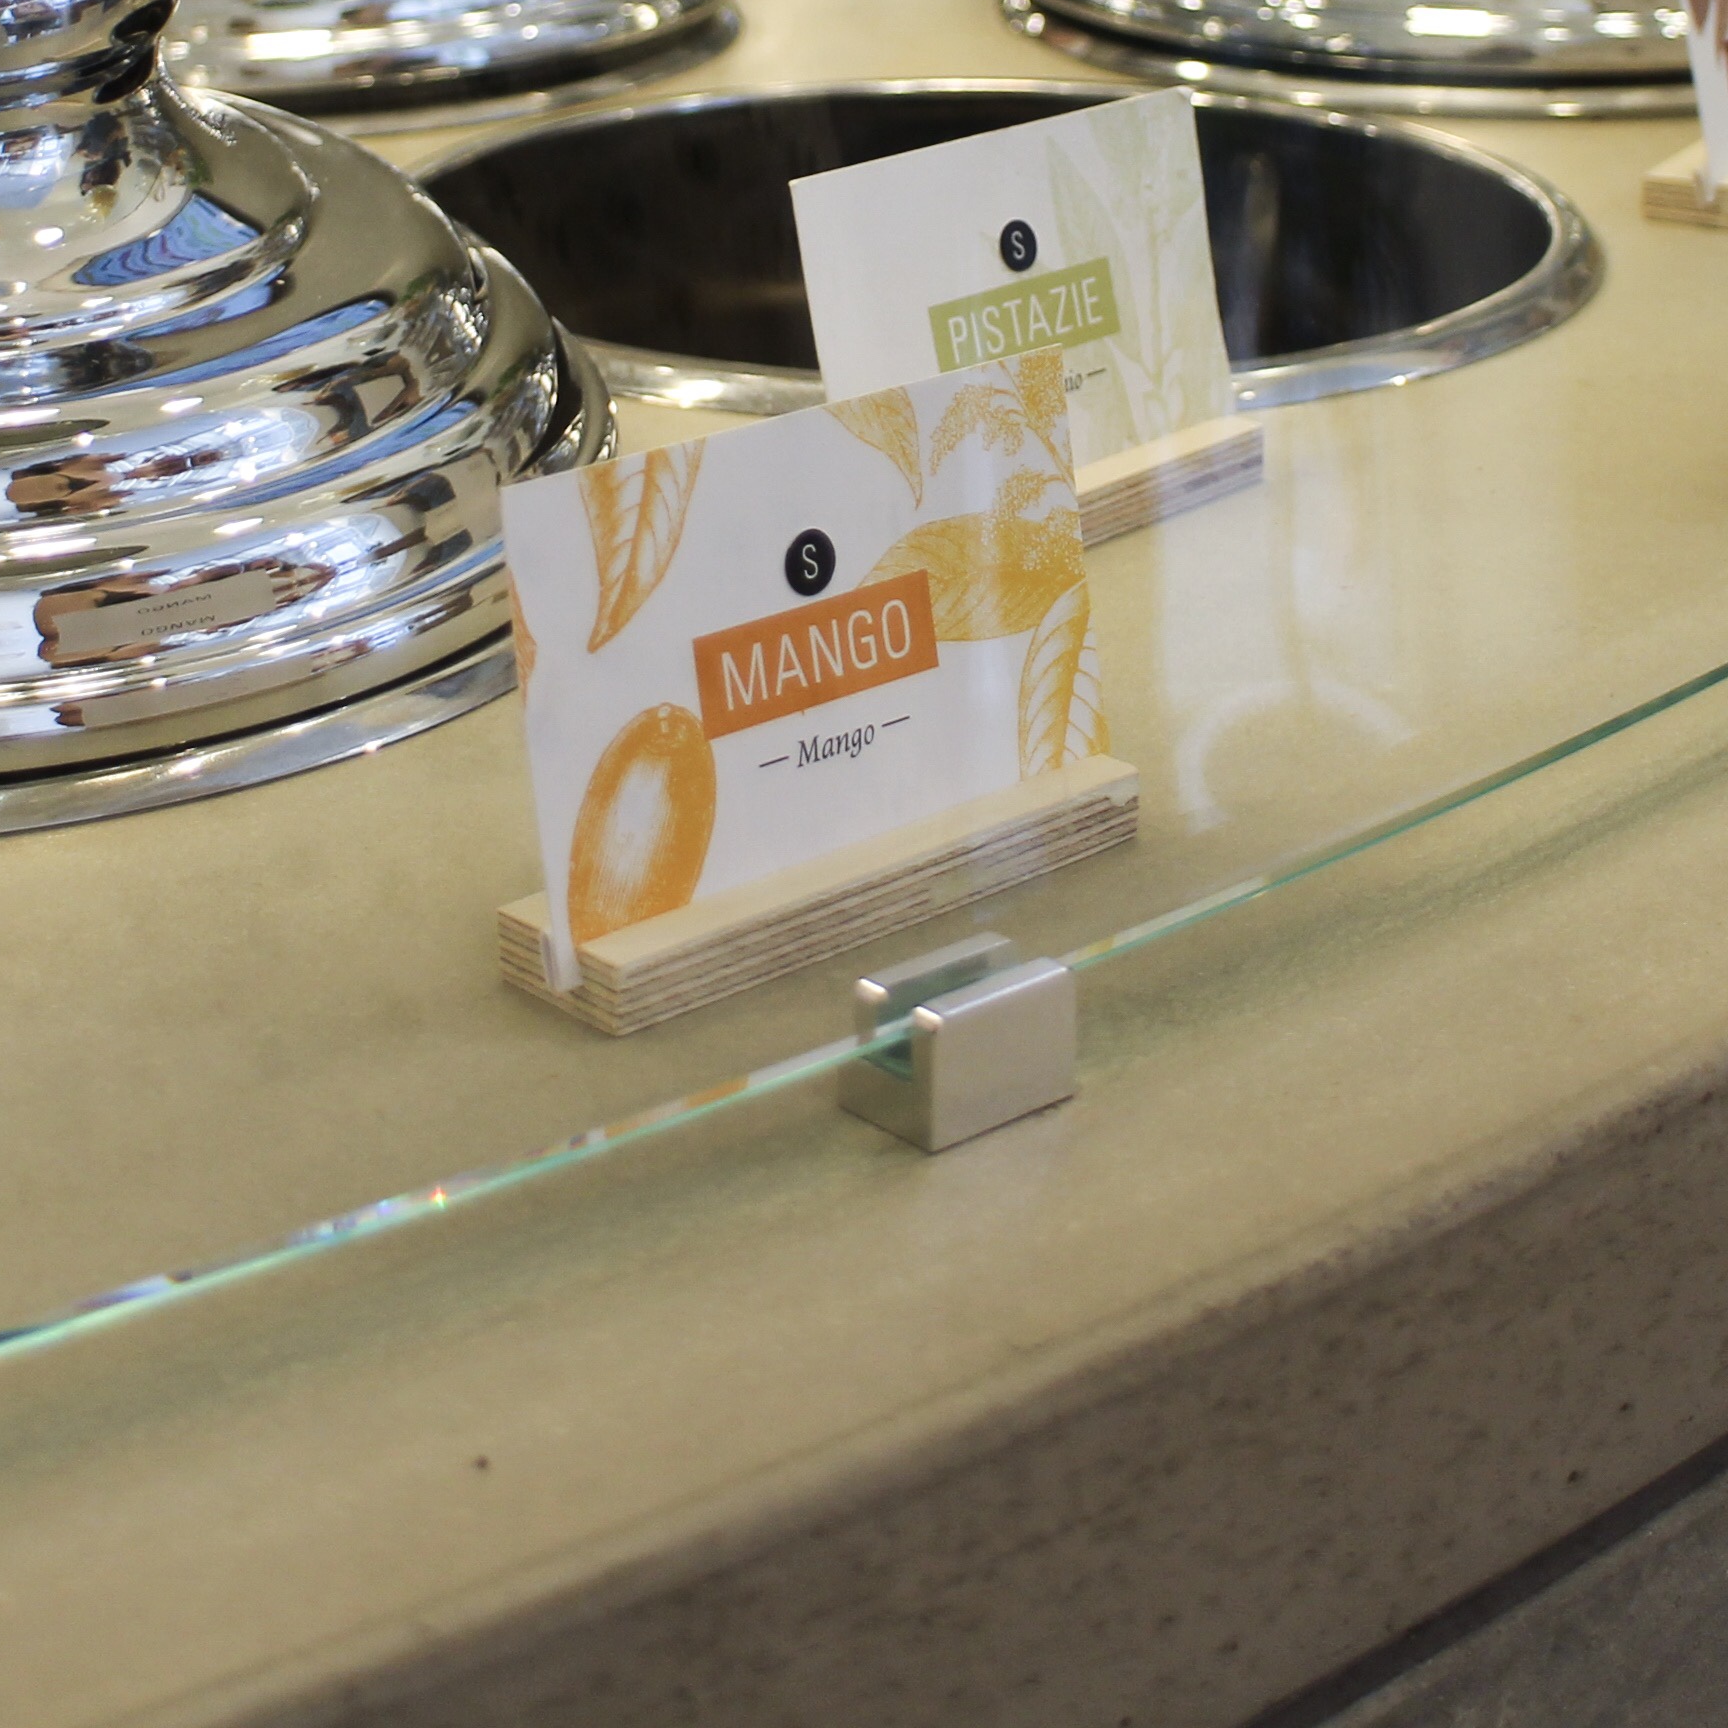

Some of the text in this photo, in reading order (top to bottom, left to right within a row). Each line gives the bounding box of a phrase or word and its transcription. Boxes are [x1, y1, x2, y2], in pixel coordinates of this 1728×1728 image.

[1010, 230, 1026, 260] S
[948, 276, 1104, 365] PISTAZIE
[801, 543, 819, 579] S
[722, 599, 911, 712] MANGO
[797, 724, 875, 768] Mango
